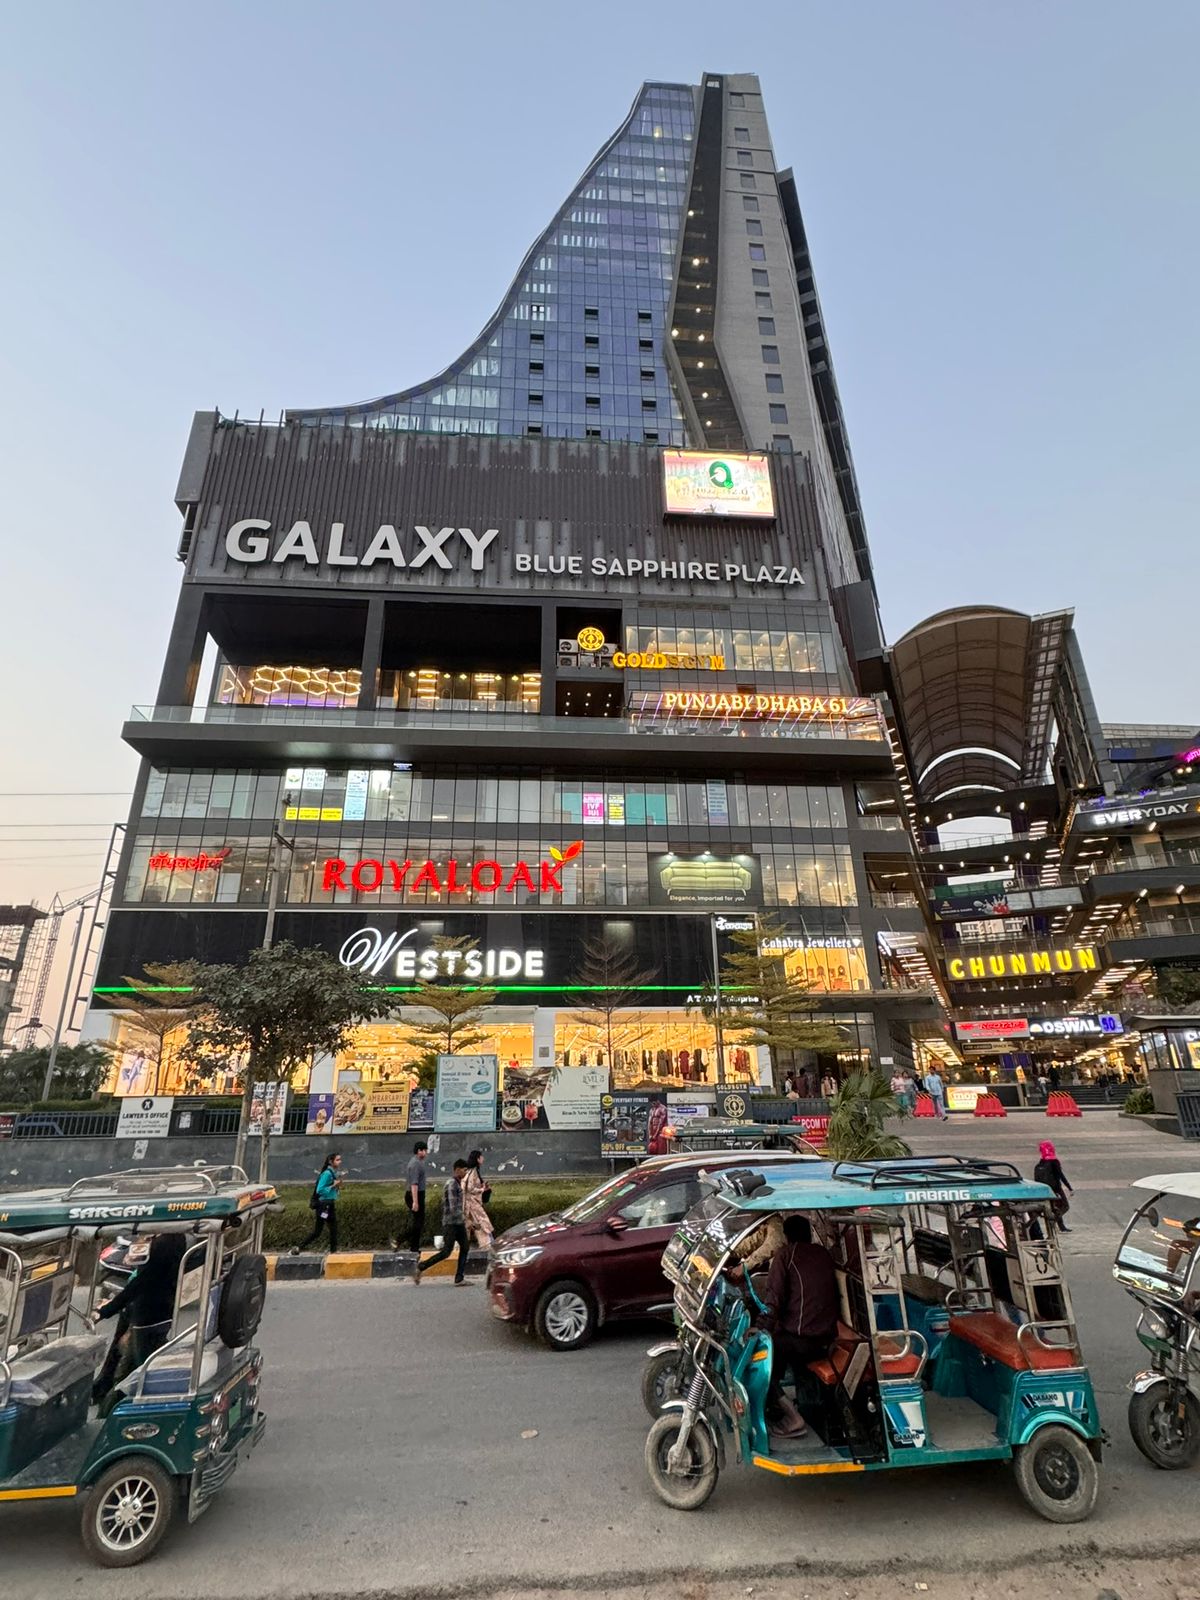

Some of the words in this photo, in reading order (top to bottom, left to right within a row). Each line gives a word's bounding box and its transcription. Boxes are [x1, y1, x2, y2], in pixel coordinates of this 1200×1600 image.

[225, 518, 499, 570] GALAXY
[515, 553, 583, 574] BLUE
[591, 558, 720, 580] SAPPHIRE
[725, 563, 806, 585] PLAZA
[683, 655, 725, 670] GYM
[665, 692, 752, 711] PUNJABI
[756, 695, 824, 712] DHABA
[829, 698, 848, 713] 61
[1093, 803, 1190, 825] EVERYDAY
[321, 858, 566, 893] ROYALOAK
[806, 937, 852, 949] Jewellers
[339, 927, 545, 977] WESTSIDE
[950, 948, 1097, 979] CHUNMUN
[1043, 1018, 1100, 1034] OSWAL
[615, 1143, 625, 1151] OFF
[905, 1189, 970, 1202] DABANG
[69, 1204, 155, 1220] SARGAM
[1033, 1393, 1058, 1401] DABANG
[894, 1433, 921, 1442] DABANG
